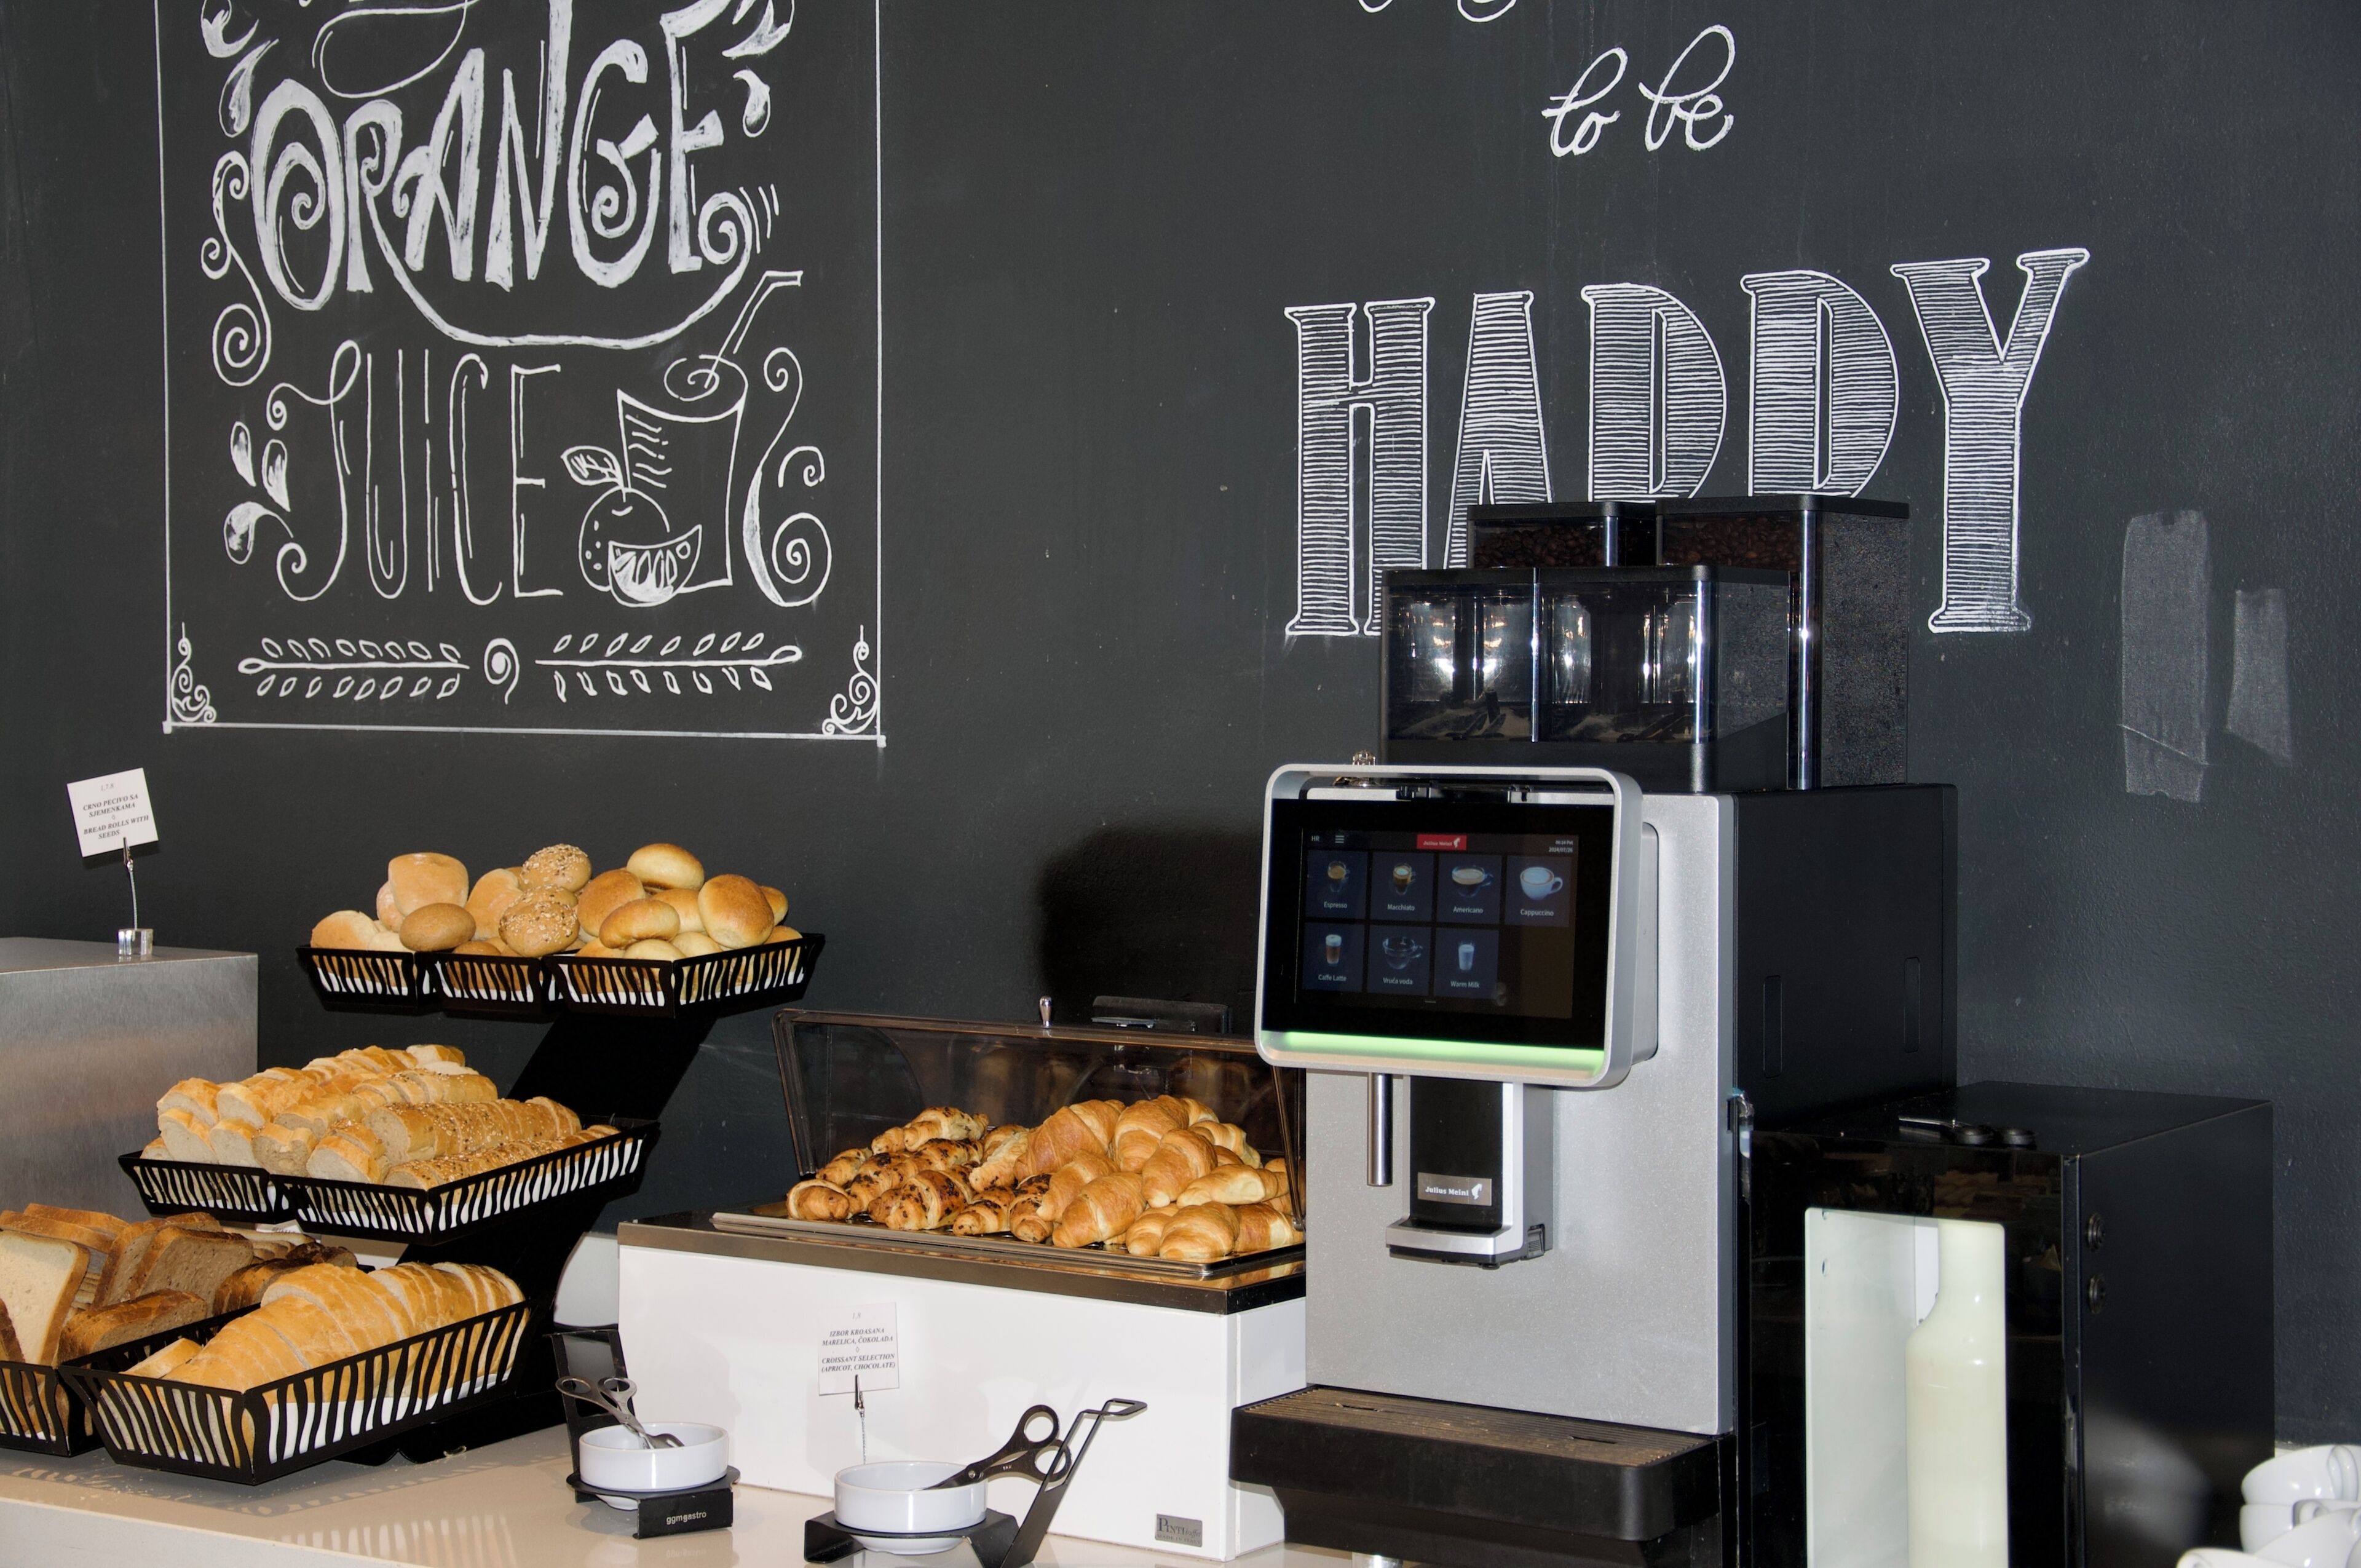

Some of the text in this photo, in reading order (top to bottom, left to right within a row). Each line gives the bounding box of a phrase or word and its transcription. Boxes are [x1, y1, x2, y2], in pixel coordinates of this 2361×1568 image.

[1541, 24, 1736, 157] to be
[250, 0, 745, 315] ORANGE
[265, 340, 564, 604] JUICE
[82, 801, 101, 811] CRNO
[103, 796, 128, 807] PECIVO
[89, 802, 135, 818] SJEMENKAMA
[84, 815, 149, 834] BREAD ROLLS WITH
[98, 830, 120, 839] SEEDS
[821, 1362, 896, 1373] (APRICOT, CHOCOLATE)
[666, 1511, 707, 1525] ggmgastro
